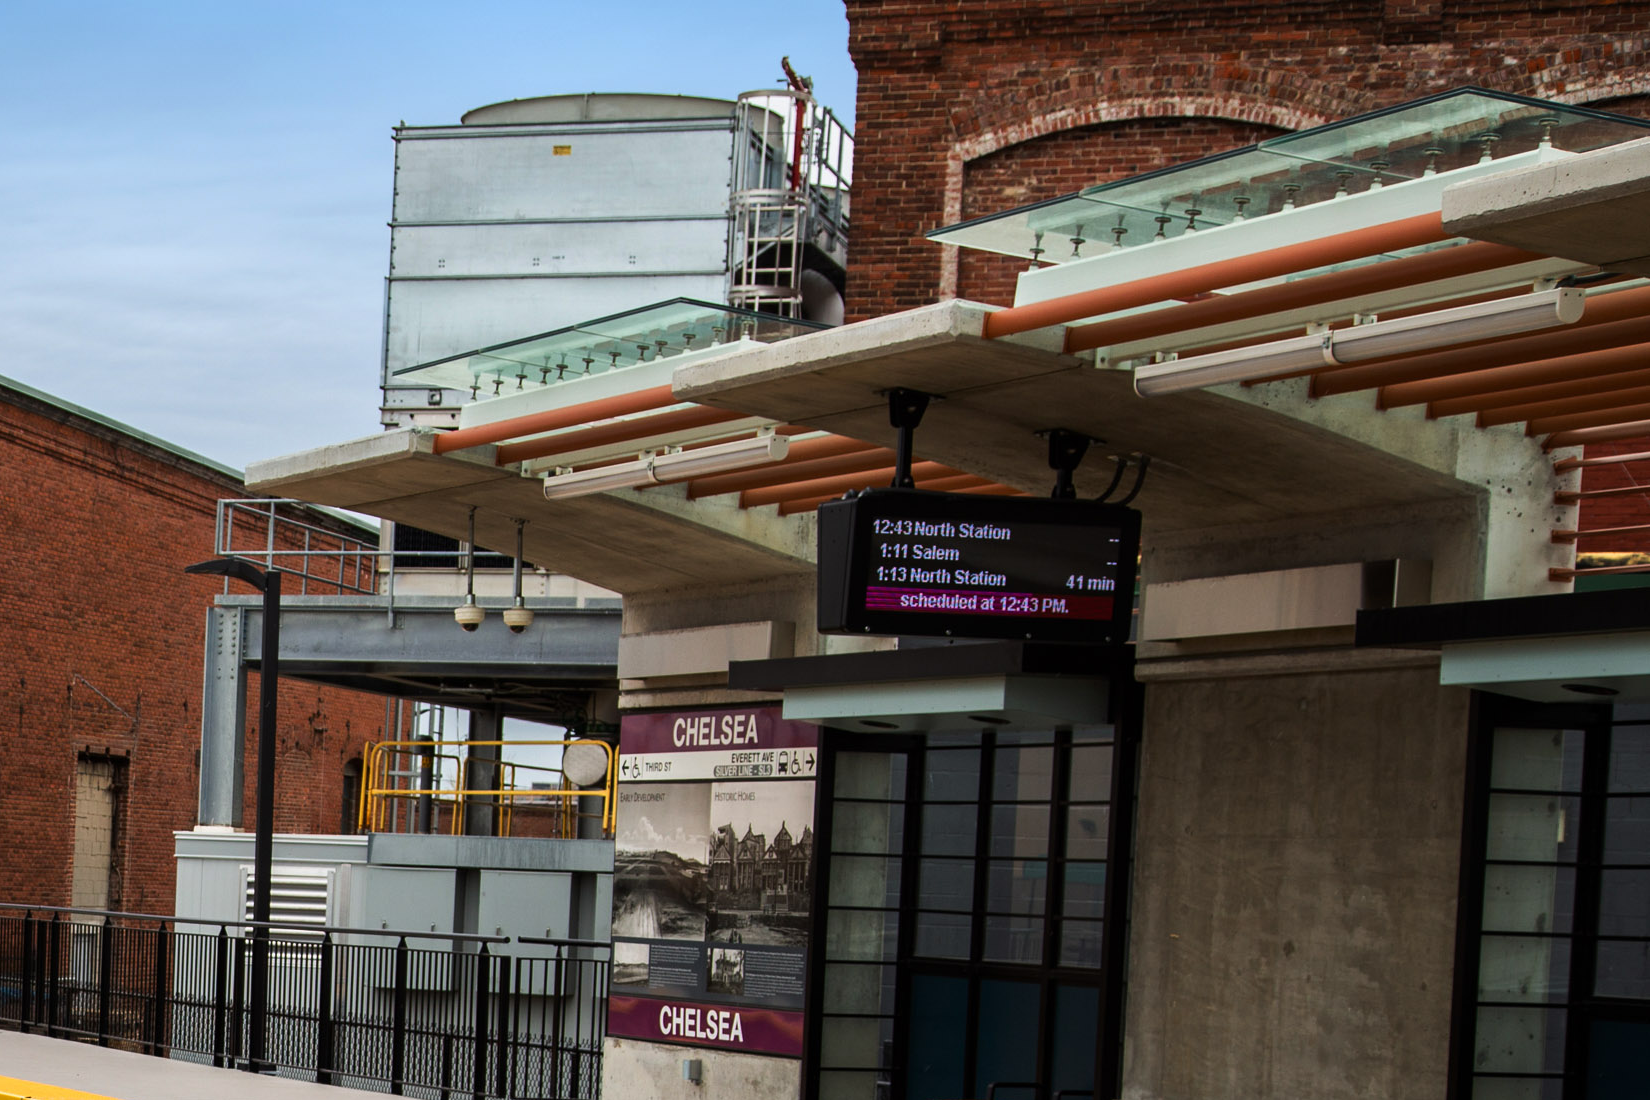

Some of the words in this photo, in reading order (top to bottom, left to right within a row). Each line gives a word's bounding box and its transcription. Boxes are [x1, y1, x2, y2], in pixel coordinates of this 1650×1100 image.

[873, 519, 912, 536] 12:43
[914, 521, 955, 538] North
[959, 523, 1011, 541] Station
[880, 543, 908, 559] 1:11
[913, 545, 959, 561] Salem
[877, 566, 906, 582] 1:13
[910, 567, 950, 584] North
[955, 570, 1007, 587] Station
[1066, 576, 1084, 590] 41
[1088, 577, 1115, 591] min
[900, 593, 977, 610] scheduled
[981, 596, 995, 610] at
[1000, 597, 1038, 612] 12:43
[1042, 599, 1069, 614] PM.
[673, 714, 759, 747] CHELSEA
[645, 763, 663, 772] THIRD
[664, 762, 672, 771] ST
[731, 752, 760, 763] EVERETT
[762, 752, 774, 762] AVE
[716, 766, 737, 776] SILVER
[738, 765, 753, 776] LINE
[759, 765, 772, 776] SL3
[715, 791, 737, 801] HISTORIC
[659, 1005, 743, 1043] CHELSEA
